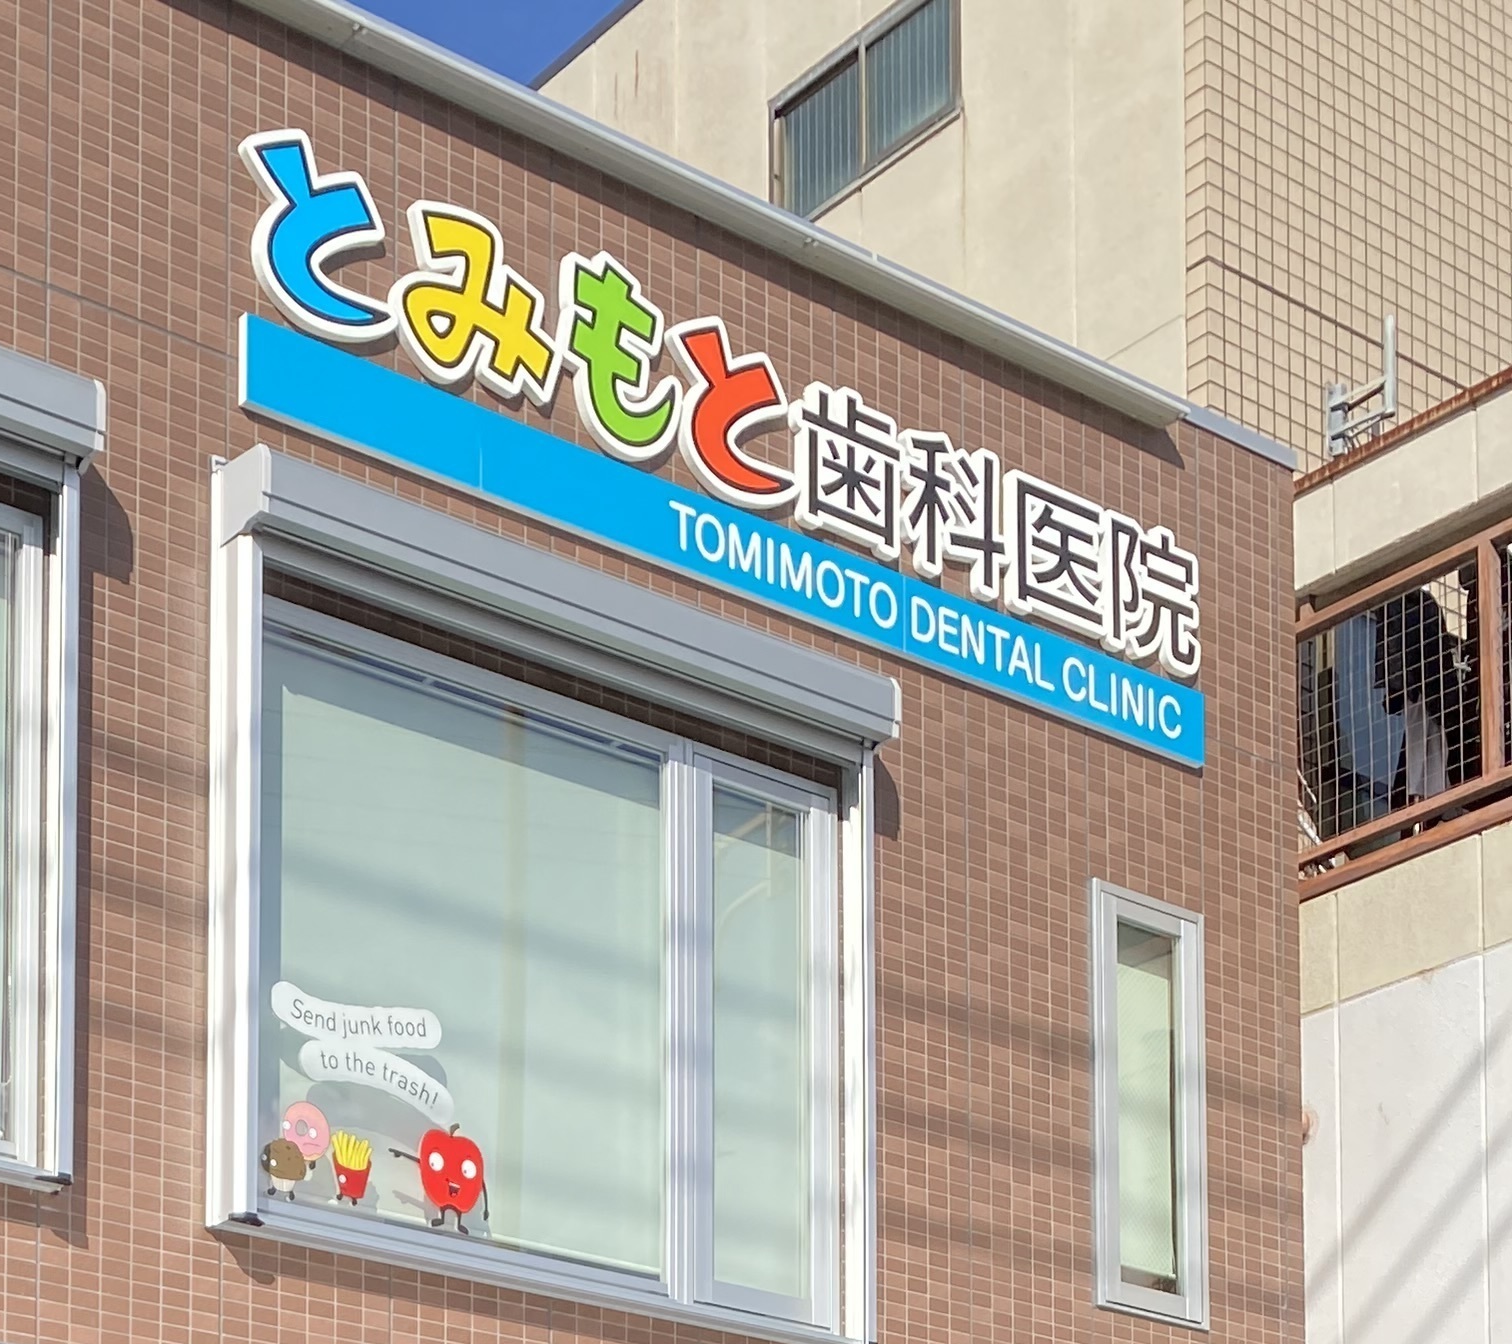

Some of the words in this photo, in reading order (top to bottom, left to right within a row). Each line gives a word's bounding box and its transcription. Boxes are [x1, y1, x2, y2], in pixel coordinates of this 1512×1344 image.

[238, 128, 1201, 676] とみもと歯科医院
[669, 500, 899, 630] TOMIMOTO
[911, 596, 1055, 692] DENTAL
[1062, 656, 1182, 740] CLINIC
[290, 998, 337, 1032] Send
[342, 1012, 383, 1039] junk
[387, 1015, 427, 1038] food
[320, 1050, 338, 1070] to
[345, 1052, 375, 1076] the
[382, 1062, 439, 1110] trash!
